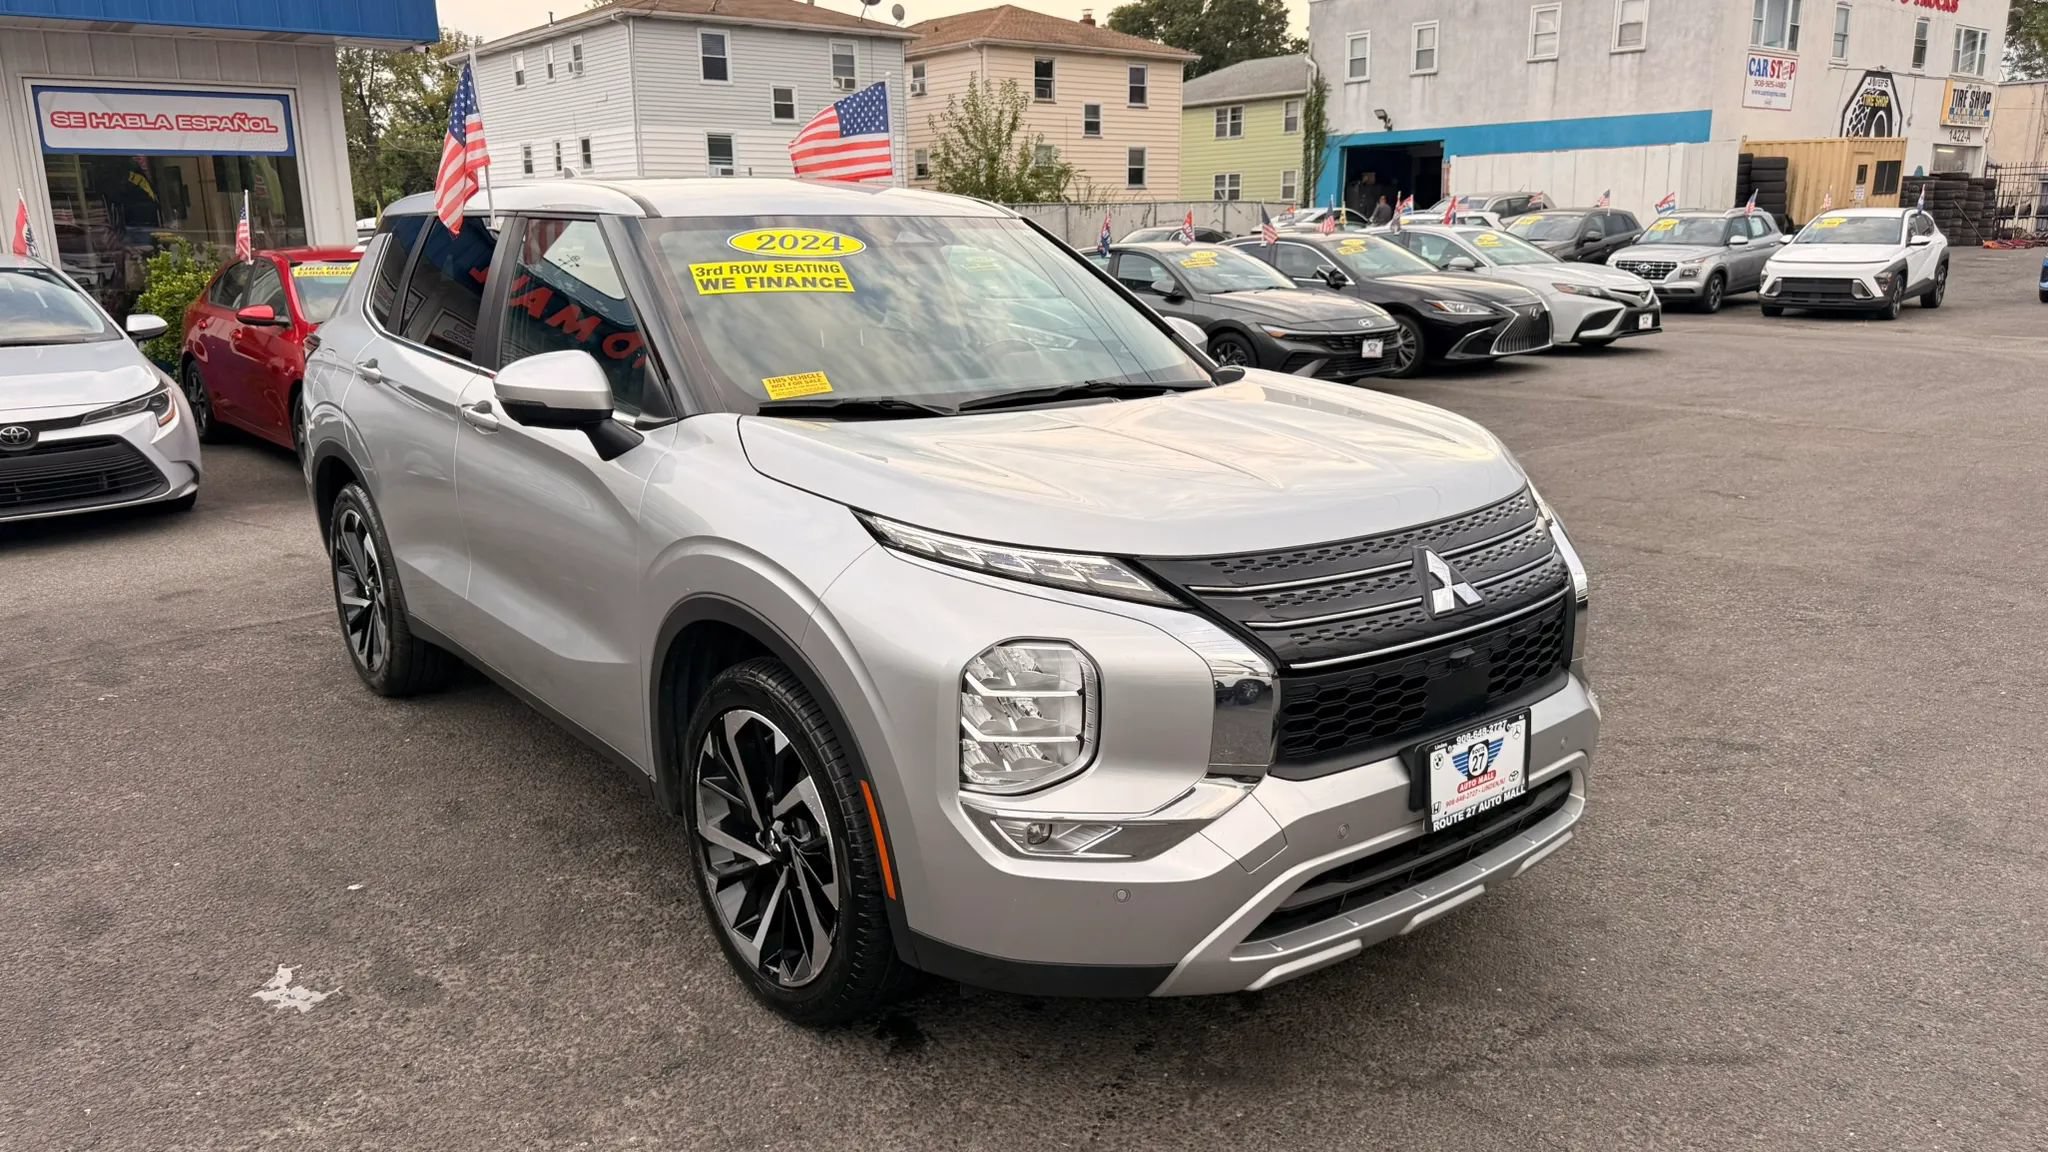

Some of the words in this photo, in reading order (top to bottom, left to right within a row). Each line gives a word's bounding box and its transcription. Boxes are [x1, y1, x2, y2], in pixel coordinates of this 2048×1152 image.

[1749, 57, 1769, 77] CAR
[1770, 59, 1796, 80] STOP
[1875, 95, 1889, 107] SHOP
[1951, 89, 1969, 108] TIRE
[1969, 90, 1992, 110] SHOP
[51, 111, 84, 128] SE
[89, 112, 173, 130] HABLA
[177, 113, 278, 133] ESPAÑOL
[756, 234, 844, 251] 2024
[695, 267, 723, 277] 3rd
[729, 264, 768, 274] ROW
[773, 263, 841, 274] SEATING
[698, 277, 736, 291] WE
[745, 276, 848, 289] FINANCE
[787, 373, 822, 382] VEHICLE
[1472, 752, 1485, 773] 27
[1460, 779, 1477, 793] AUTO
[1478, 771, 1496, 785] MALL
[1432, 810, 1465, 832] ROUTE
[1466, 805, 1477, 818] 27
[1478, 795, 1502, 813] AUTO
[1503, 785, 1527, 802] MALL
